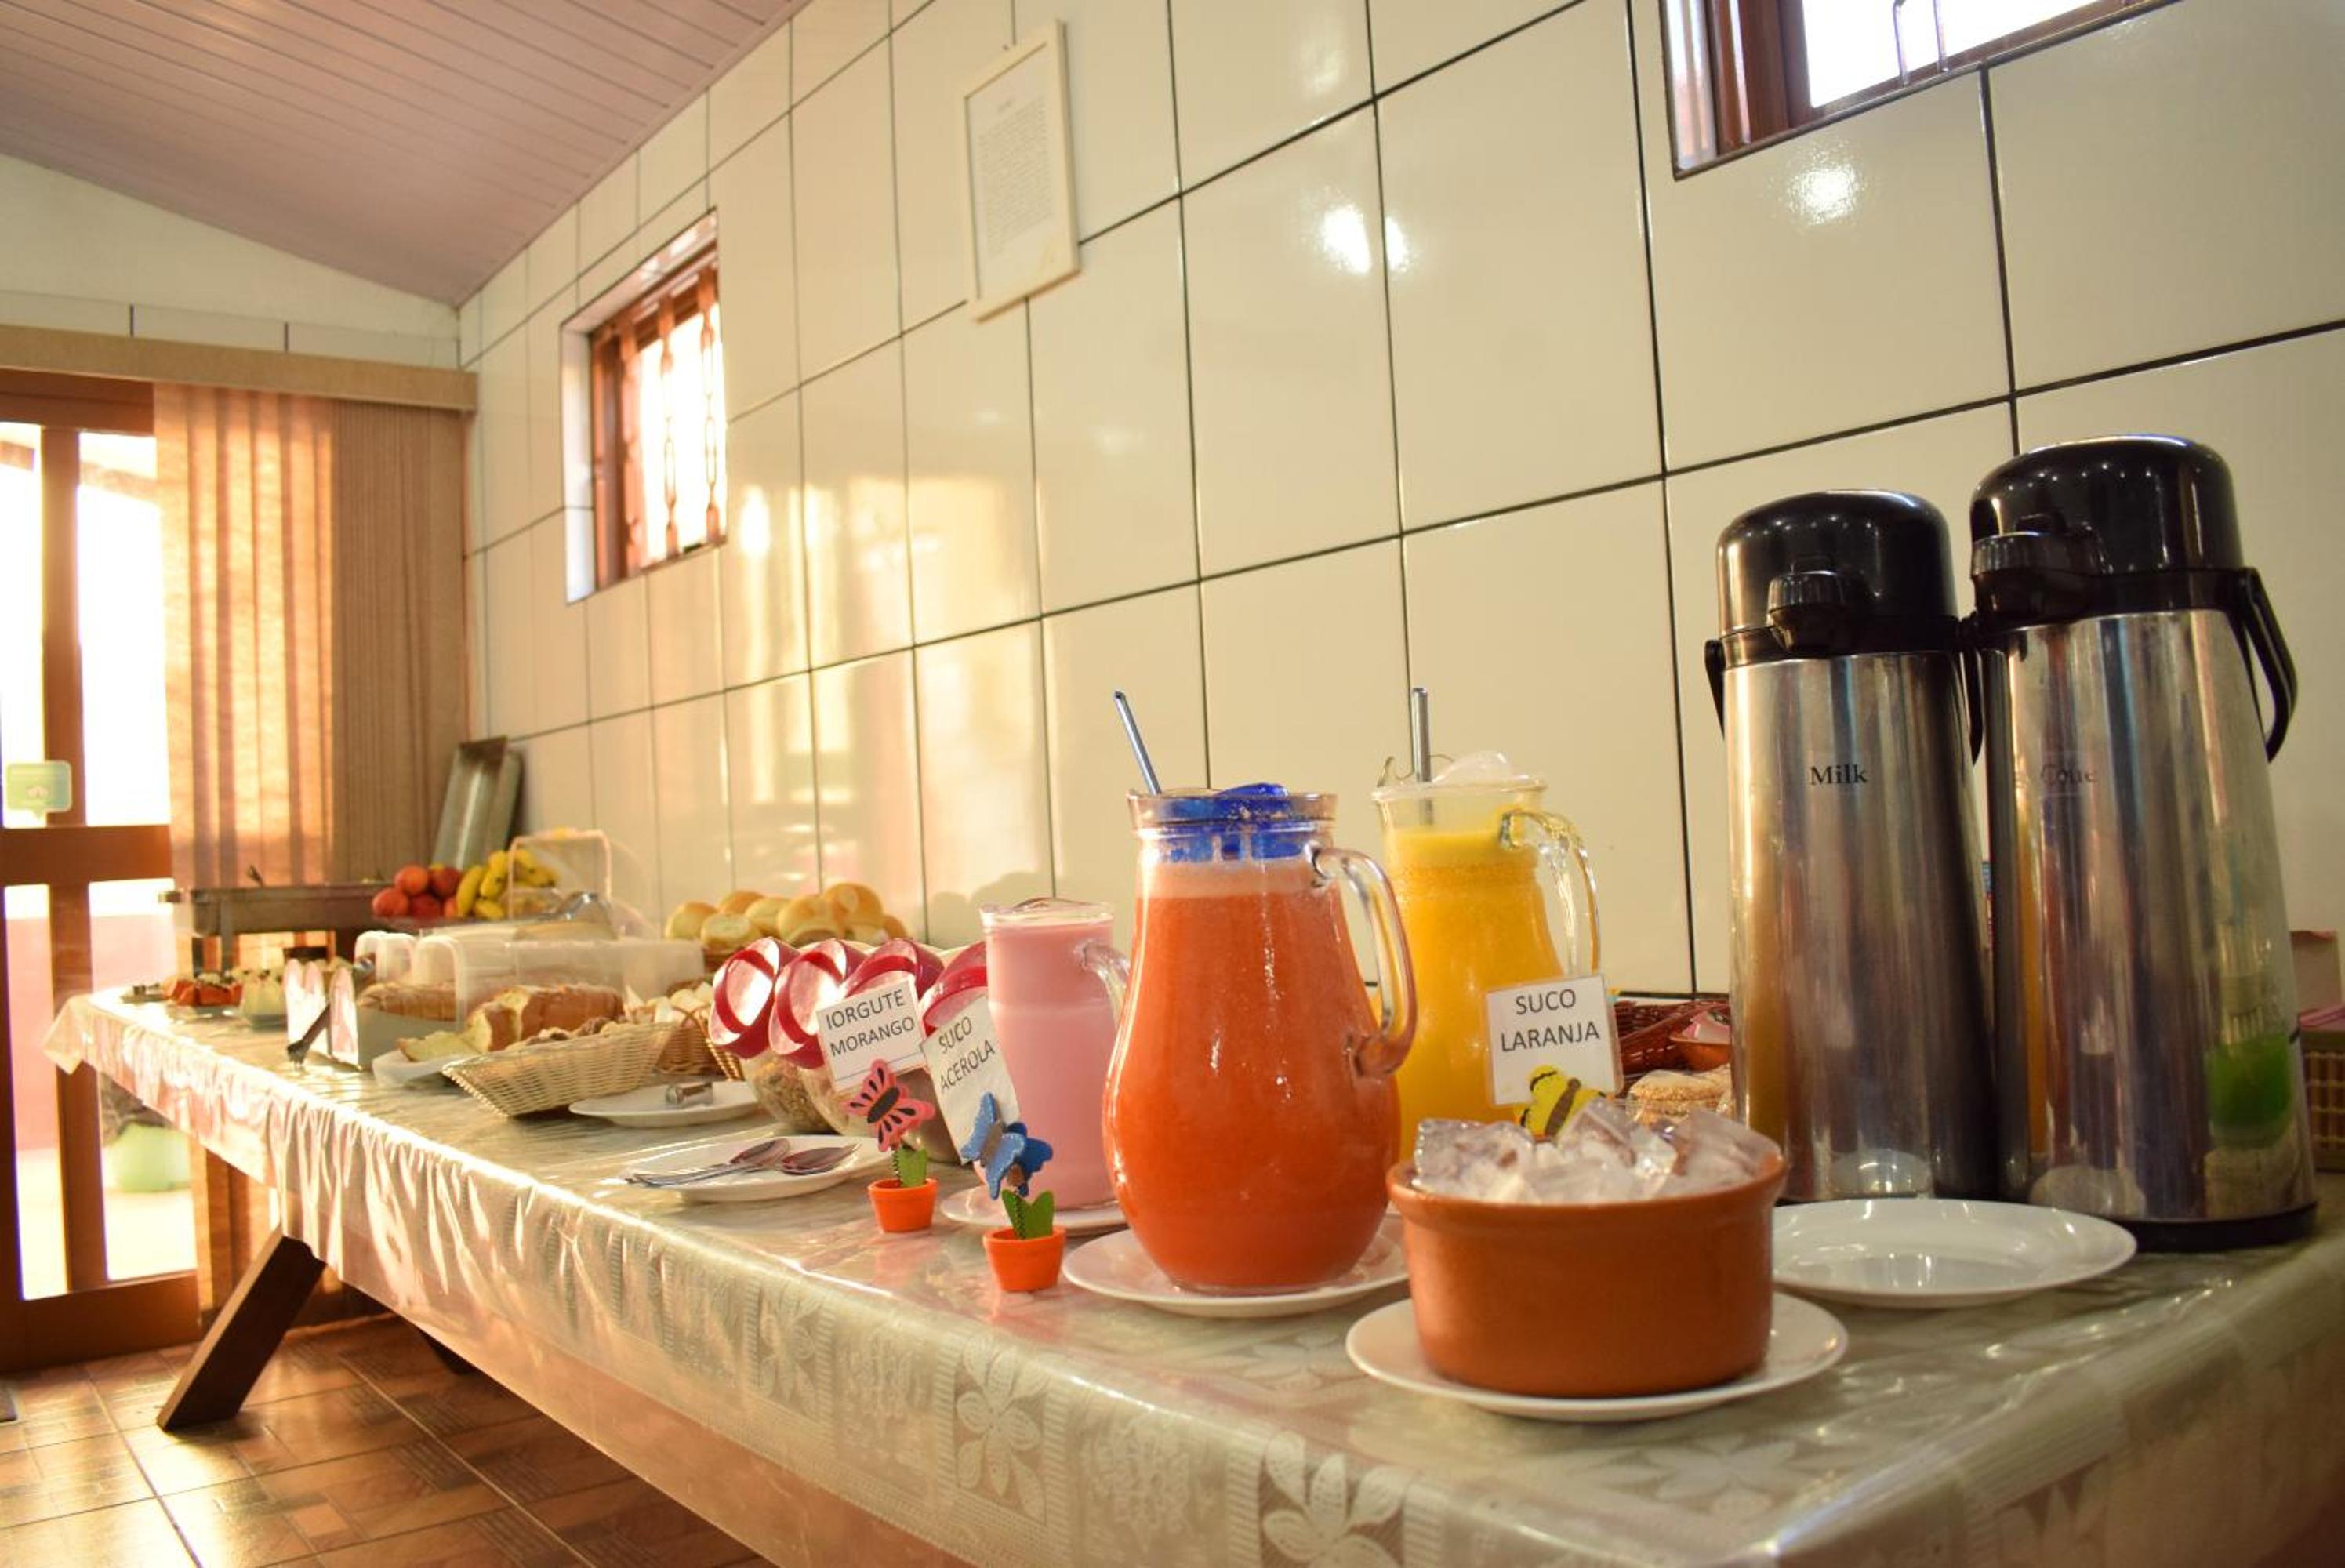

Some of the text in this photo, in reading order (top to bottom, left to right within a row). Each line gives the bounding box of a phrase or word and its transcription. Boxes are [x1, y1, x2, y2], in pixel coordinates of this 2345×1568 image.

[1810, 764, 1869, 786] Milk
[826, 989, 906, 1032] IORGUTE
[1516, 989, 1577, 1016] SUCO
[829, 1017, 916, 1058] MORANGO
[938, 1016, 972, 1054] SUCO
[1501, 1021, 1600, 1052] LARANJA
[940, 1039, 996, 1092] ACEROLA
